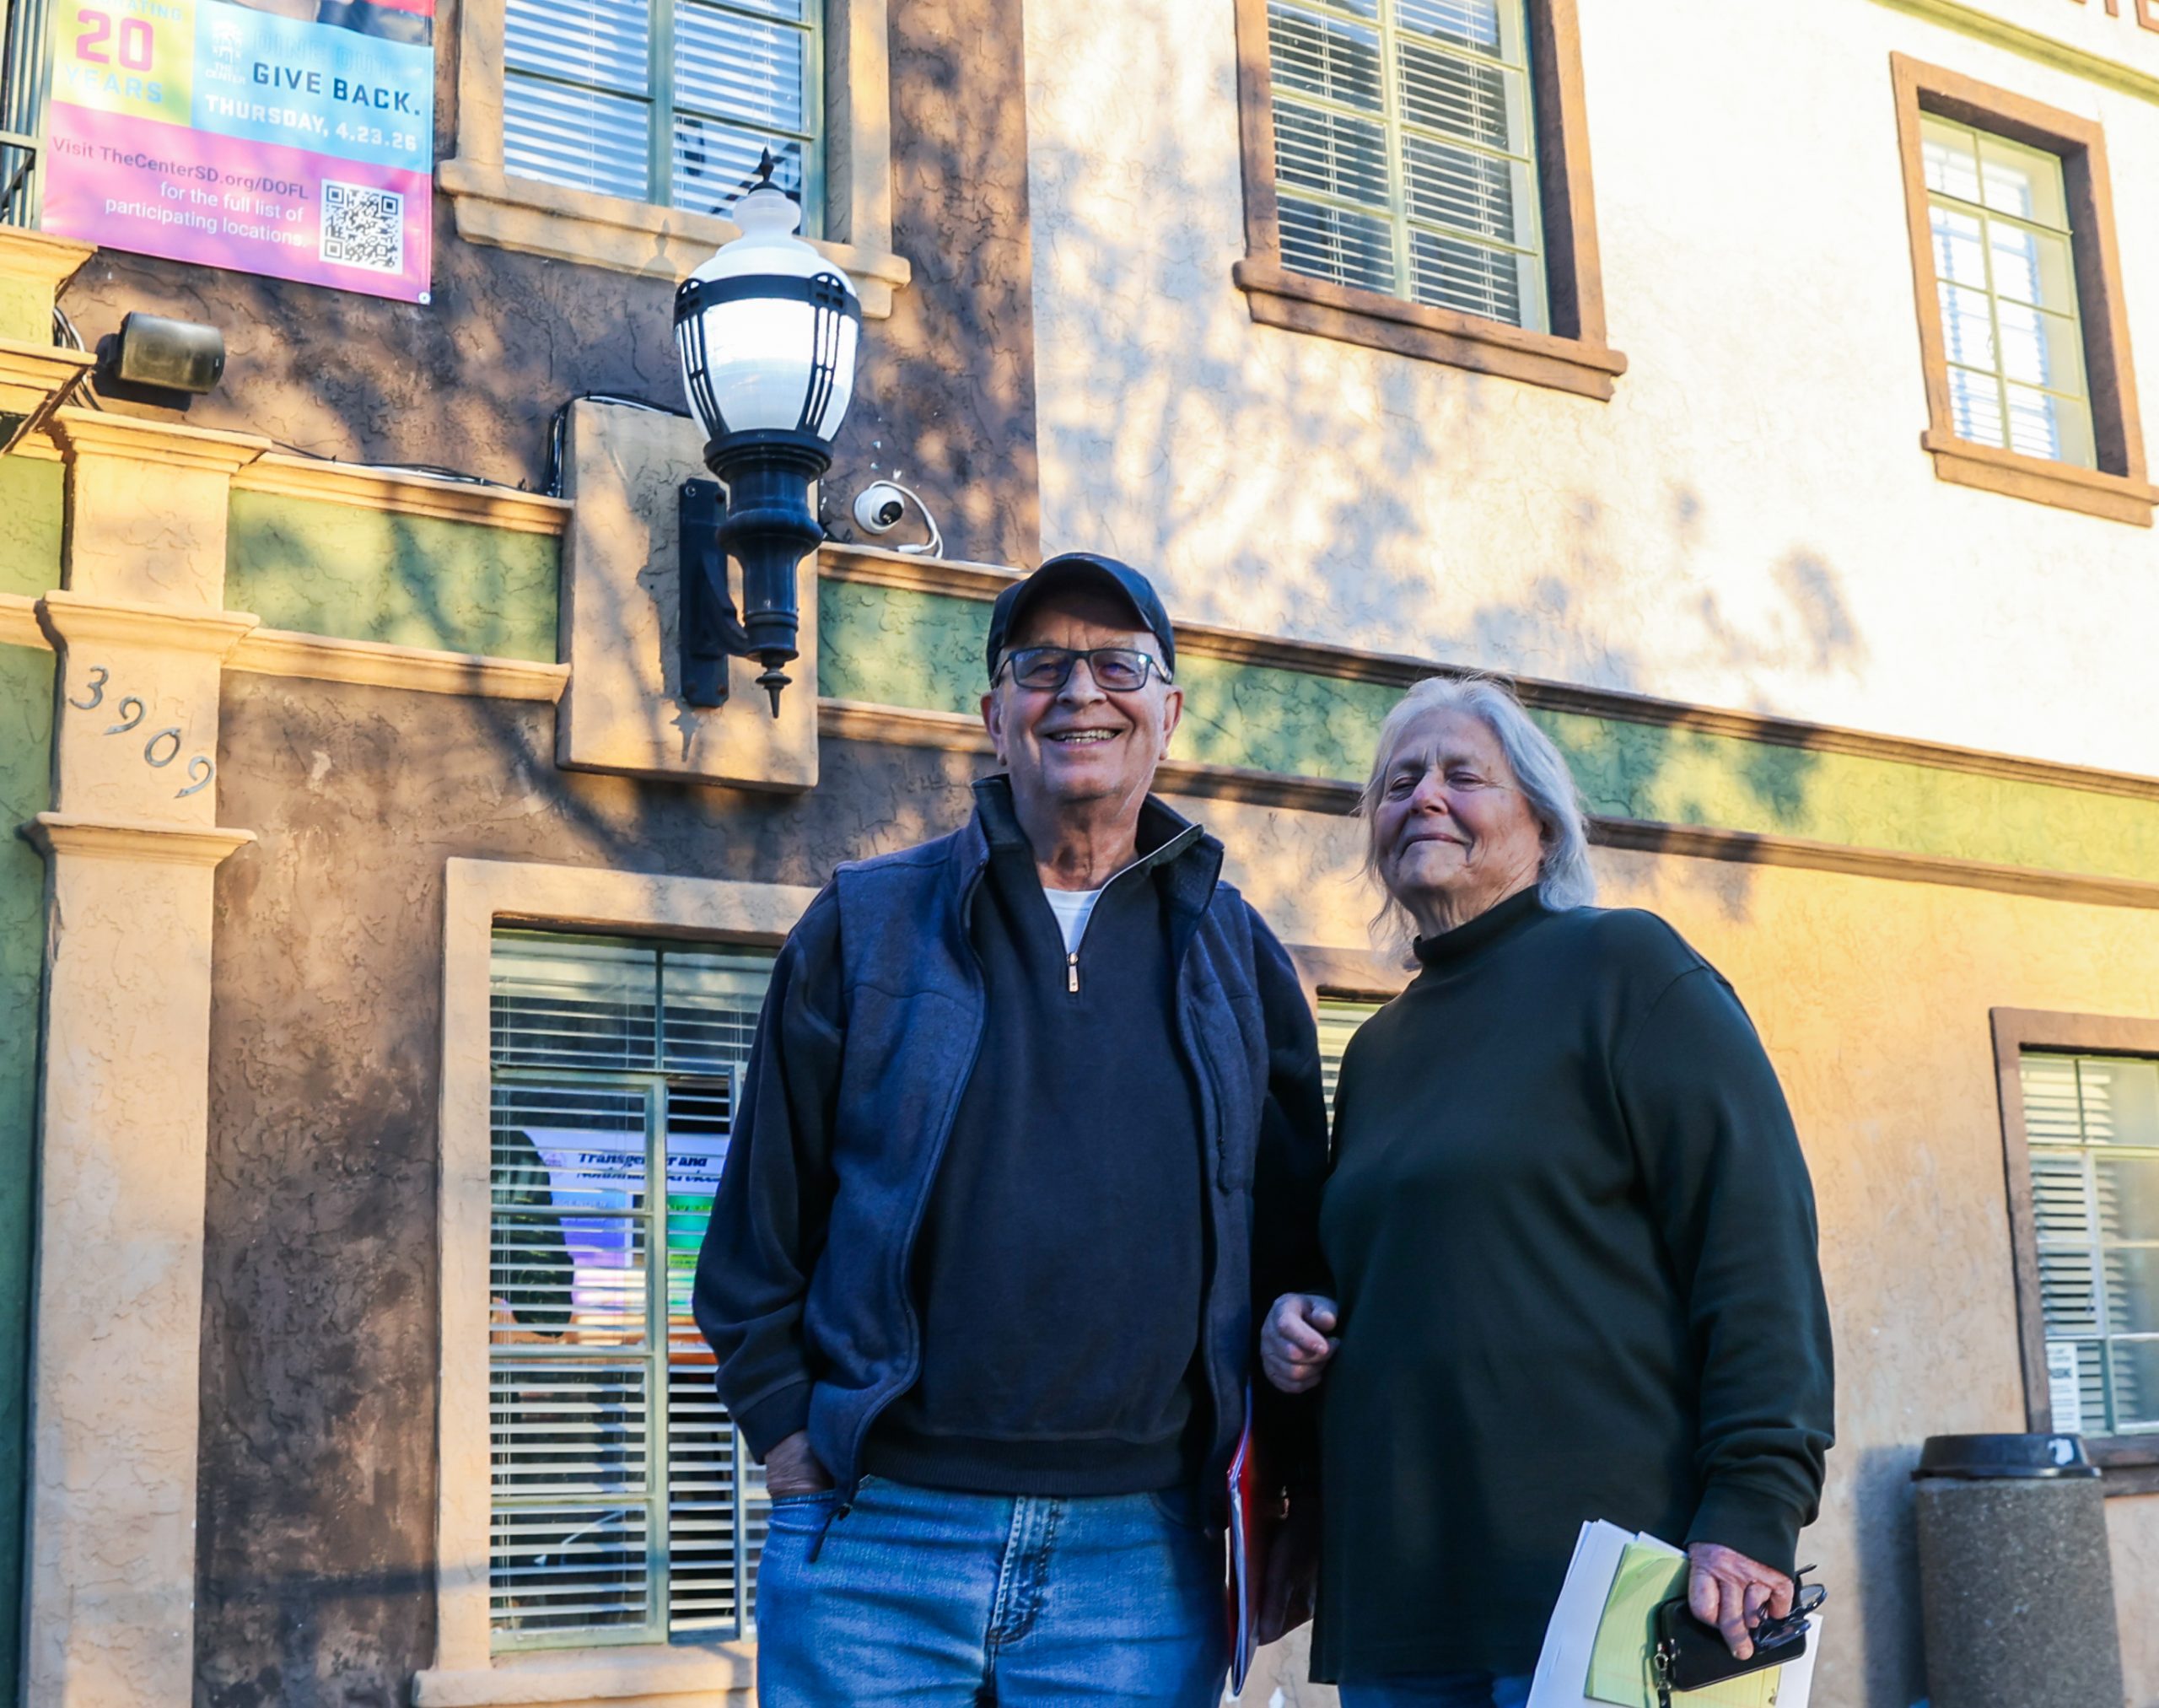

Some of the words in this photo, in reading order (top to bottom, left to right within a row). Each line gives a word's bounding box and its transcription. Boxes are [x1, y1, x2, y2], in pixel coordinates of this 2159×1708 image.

[76, 8, 153, 72] 20
[65, 63, 163, 104] YEARS
[253, 62, 321, 94] GIVE
[333, 78, 421, 116] BACK.
[205, 94, 329, 137] THURSDAY,
[336, 121, 417, 152] 4.23.26
[53, 136, 94, 159] Visit
[100, 145, 309, 200] TheCenterSD.org/DOFL
[105, 198, 218, 234] participating
[223, 216, 307, 249] locations.
[160, 180, 186, 201] for
[191, 188, 218, 207] the
[223, 193, 250, 213] full
[256, 198, 281, 219] list
[285, 207, 304, 223] of
[68, 665, 215, 799] 3909
